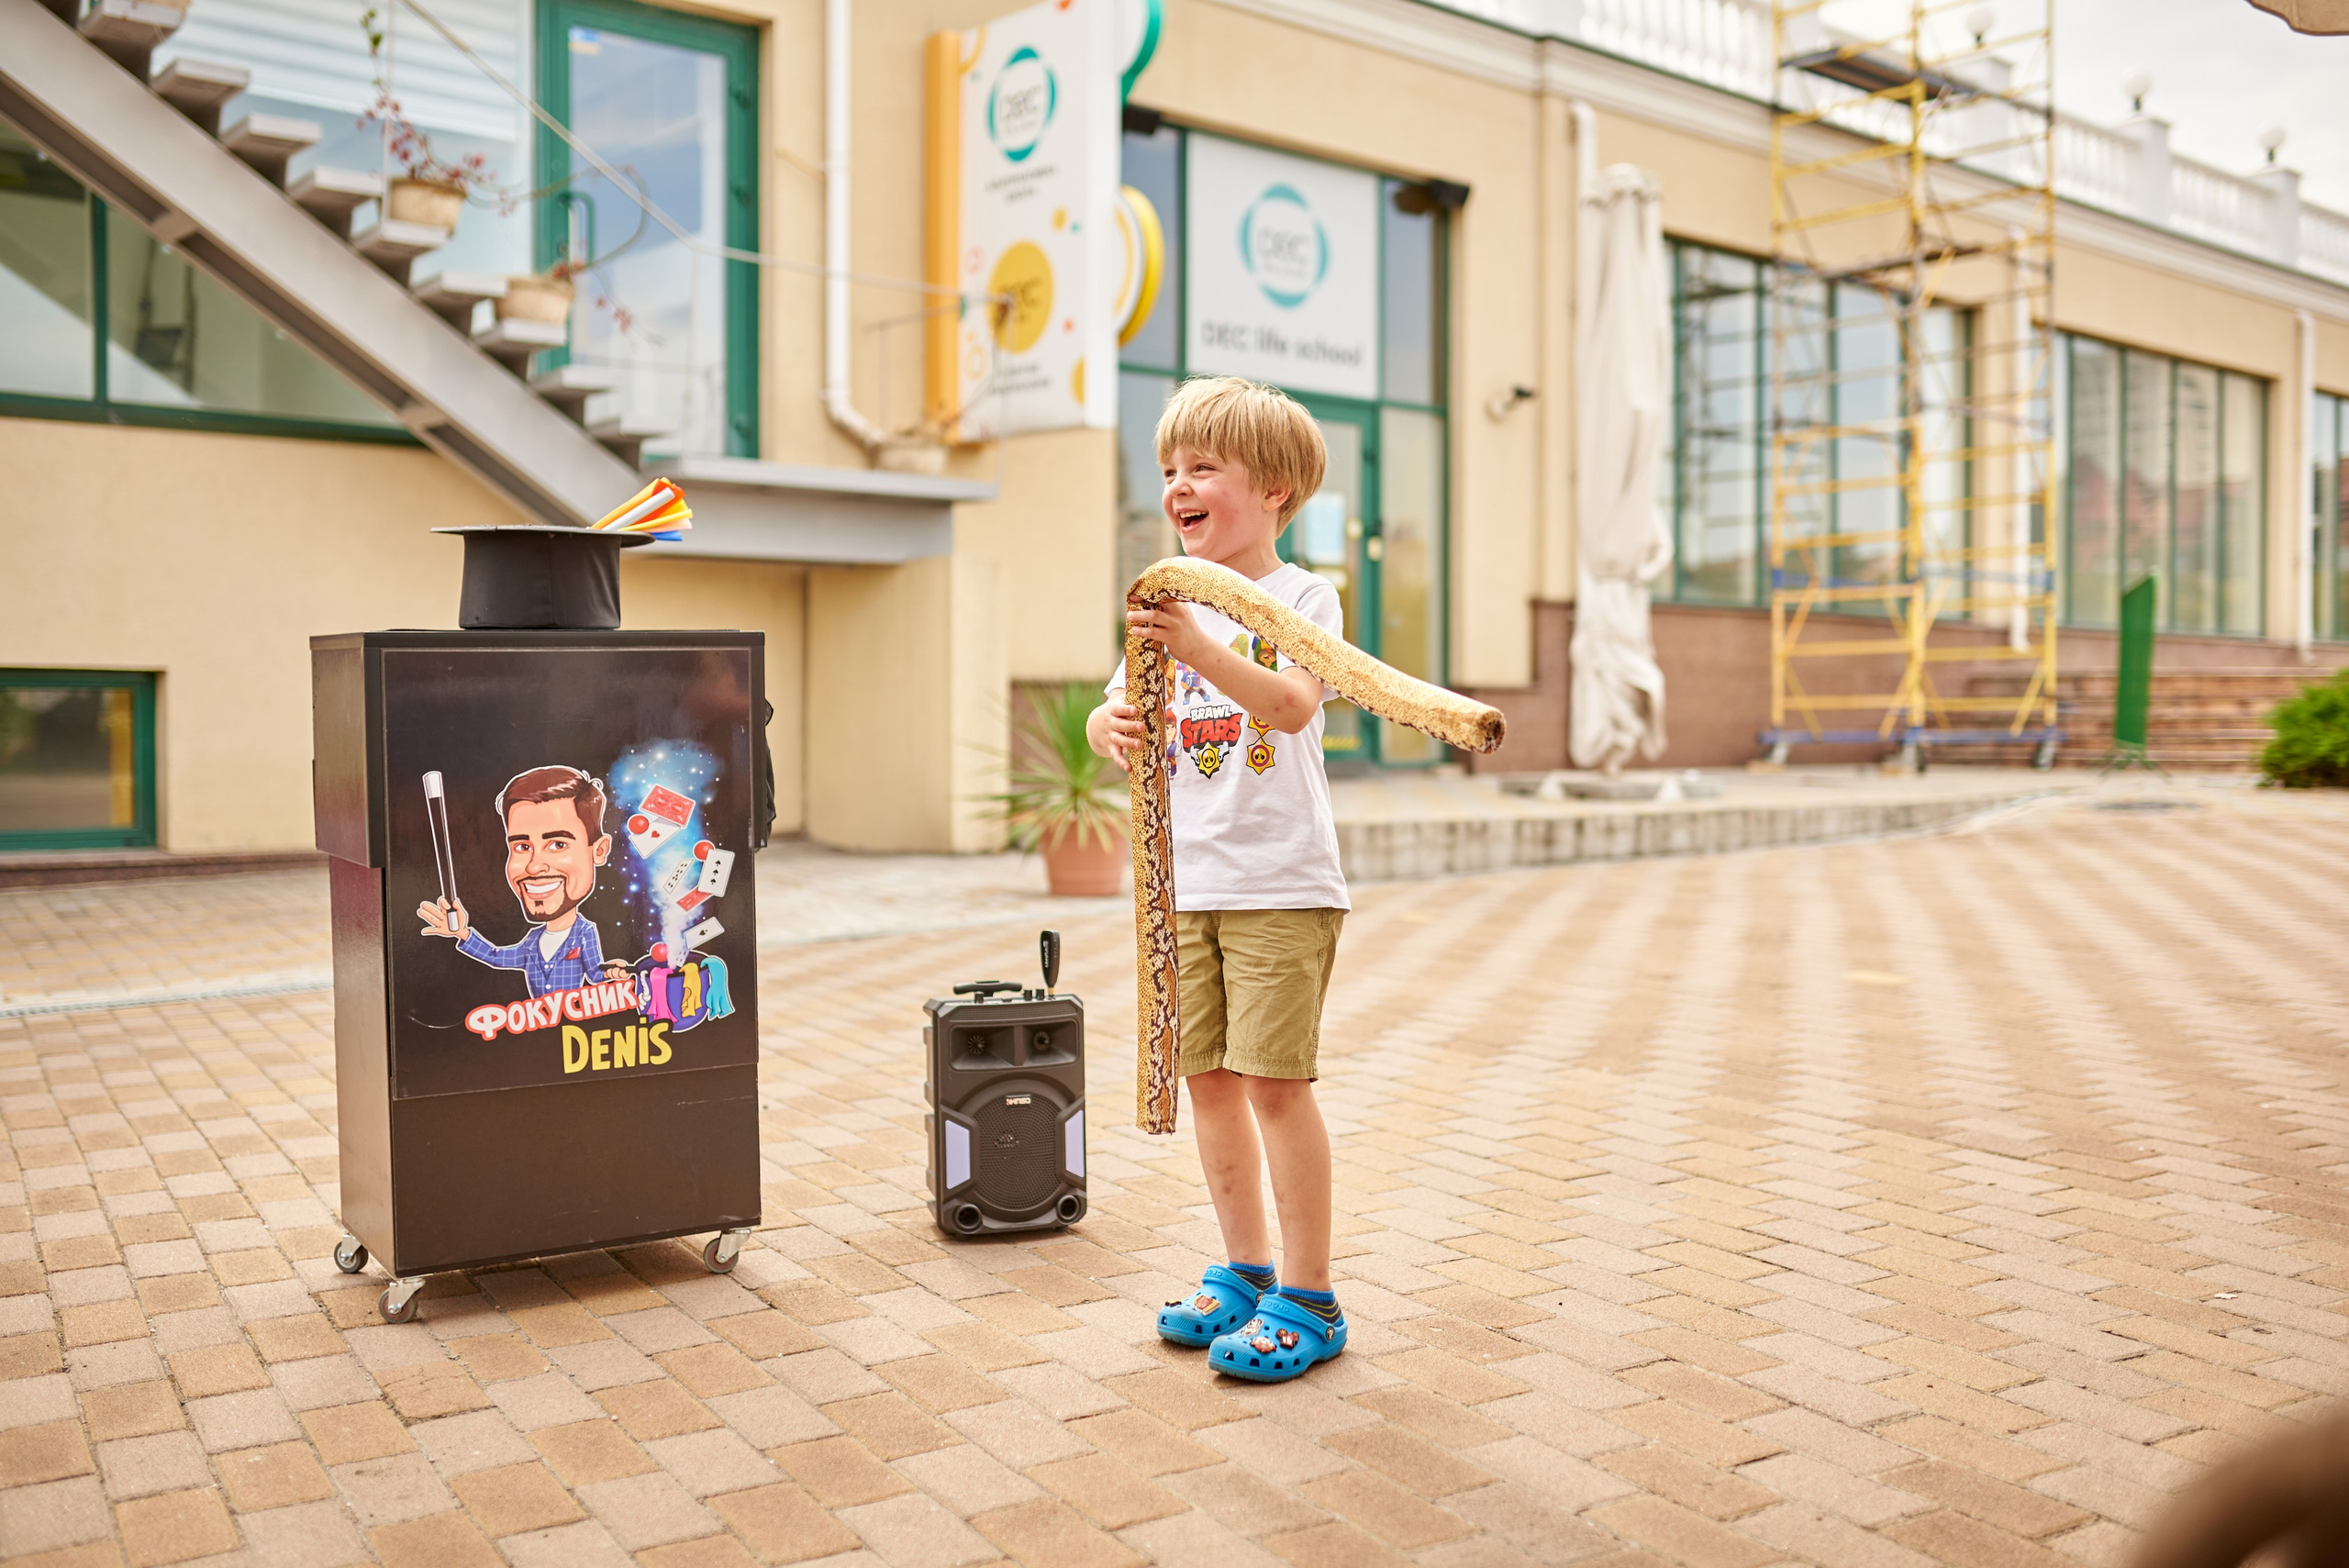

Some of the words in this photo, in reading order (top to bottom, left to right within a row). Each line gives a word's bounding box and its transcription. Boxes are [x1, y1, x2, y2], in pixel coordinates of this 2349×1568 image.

[1200, 320, 1249, 352] DEC
[1253, 325, 1287, 356] life
[1295, 339, 1364, 368] school
[1181, 713, 1242, 748] STARS
[1190, 705, 1232, 722] BRAWL
[466, 979, 640, 1040] ФОКУСНИК
